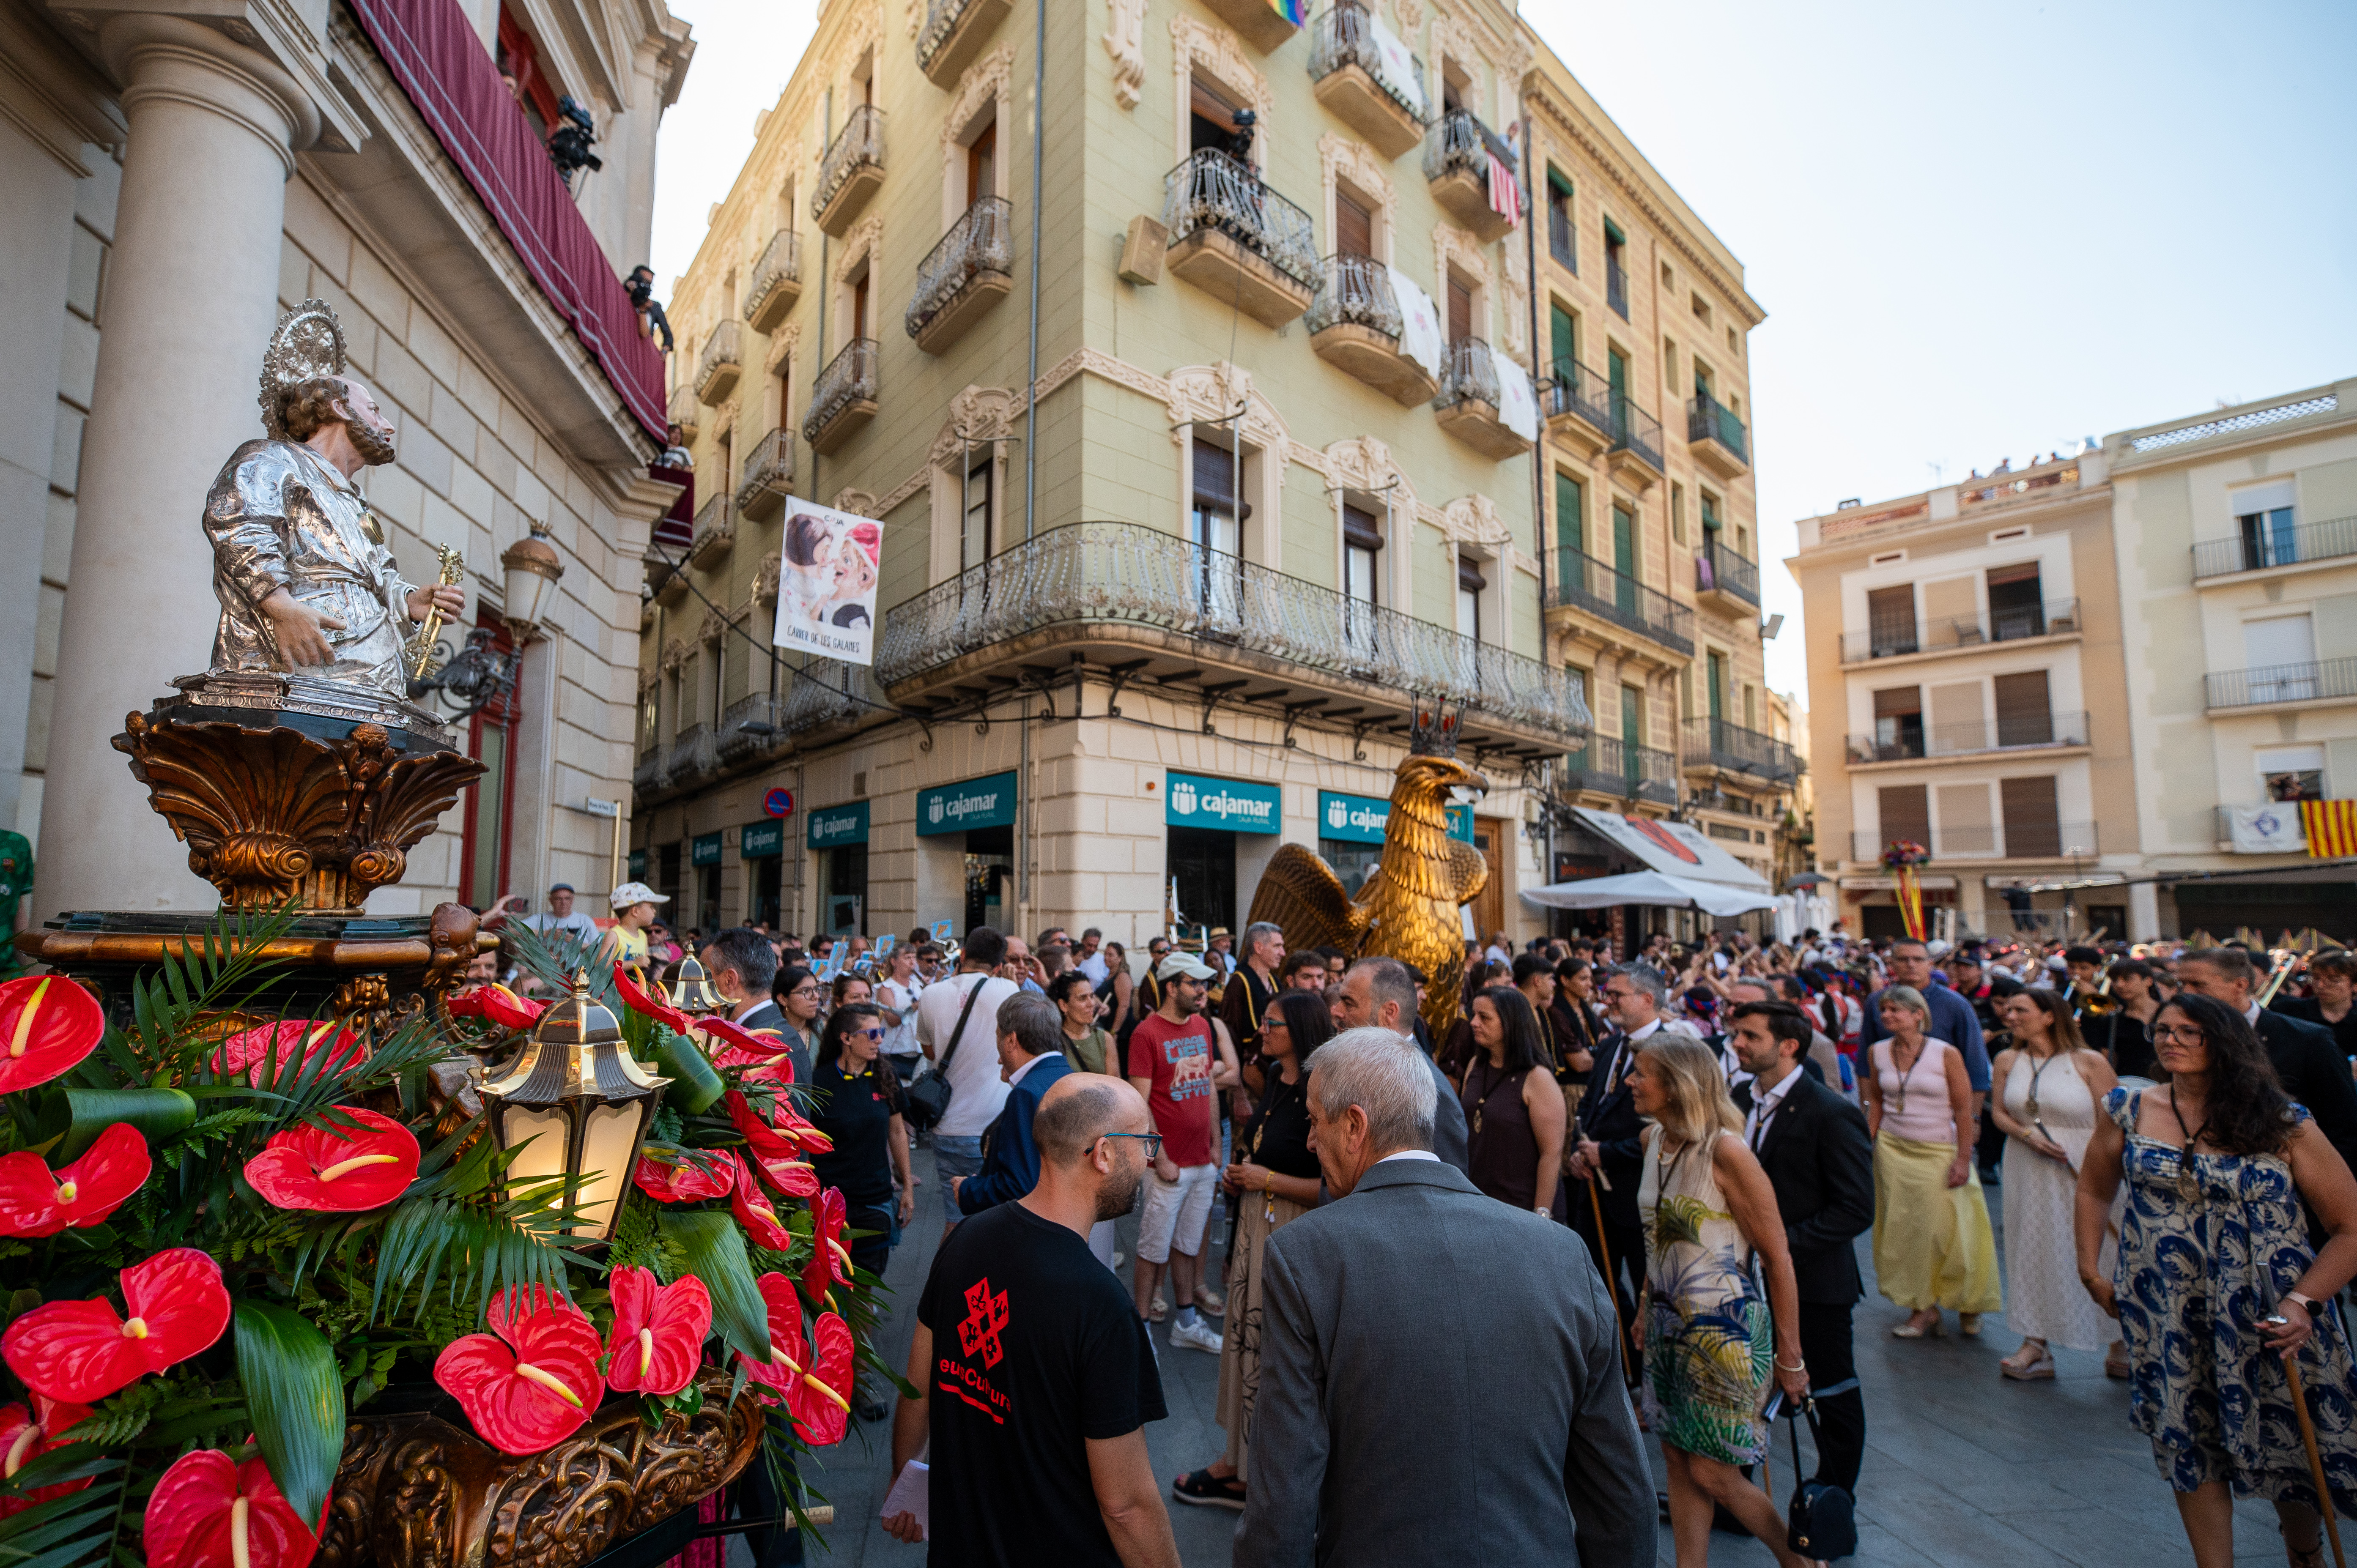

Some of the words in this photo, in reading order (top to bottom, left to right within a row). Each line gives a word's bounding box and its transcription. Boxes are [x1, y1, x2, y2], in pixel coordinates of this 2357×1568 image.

[787, 624, 809, 642] CARRER
[810, 632, 819, 645] DE
[820, 634, 831, 647] LES
[946, 792, 998, 821] cajamar
[1200, 789, 1272, 820] cajamar
[824, 815, 858, 838] cajamar
[753, 830, 777, 850] cajamar
[1163, 1034, 1206, 1050] SAVAGE
[1165, 1043, 1208, 1064] LIFE
[939, 1359, 1011, 1413] eusCultura
